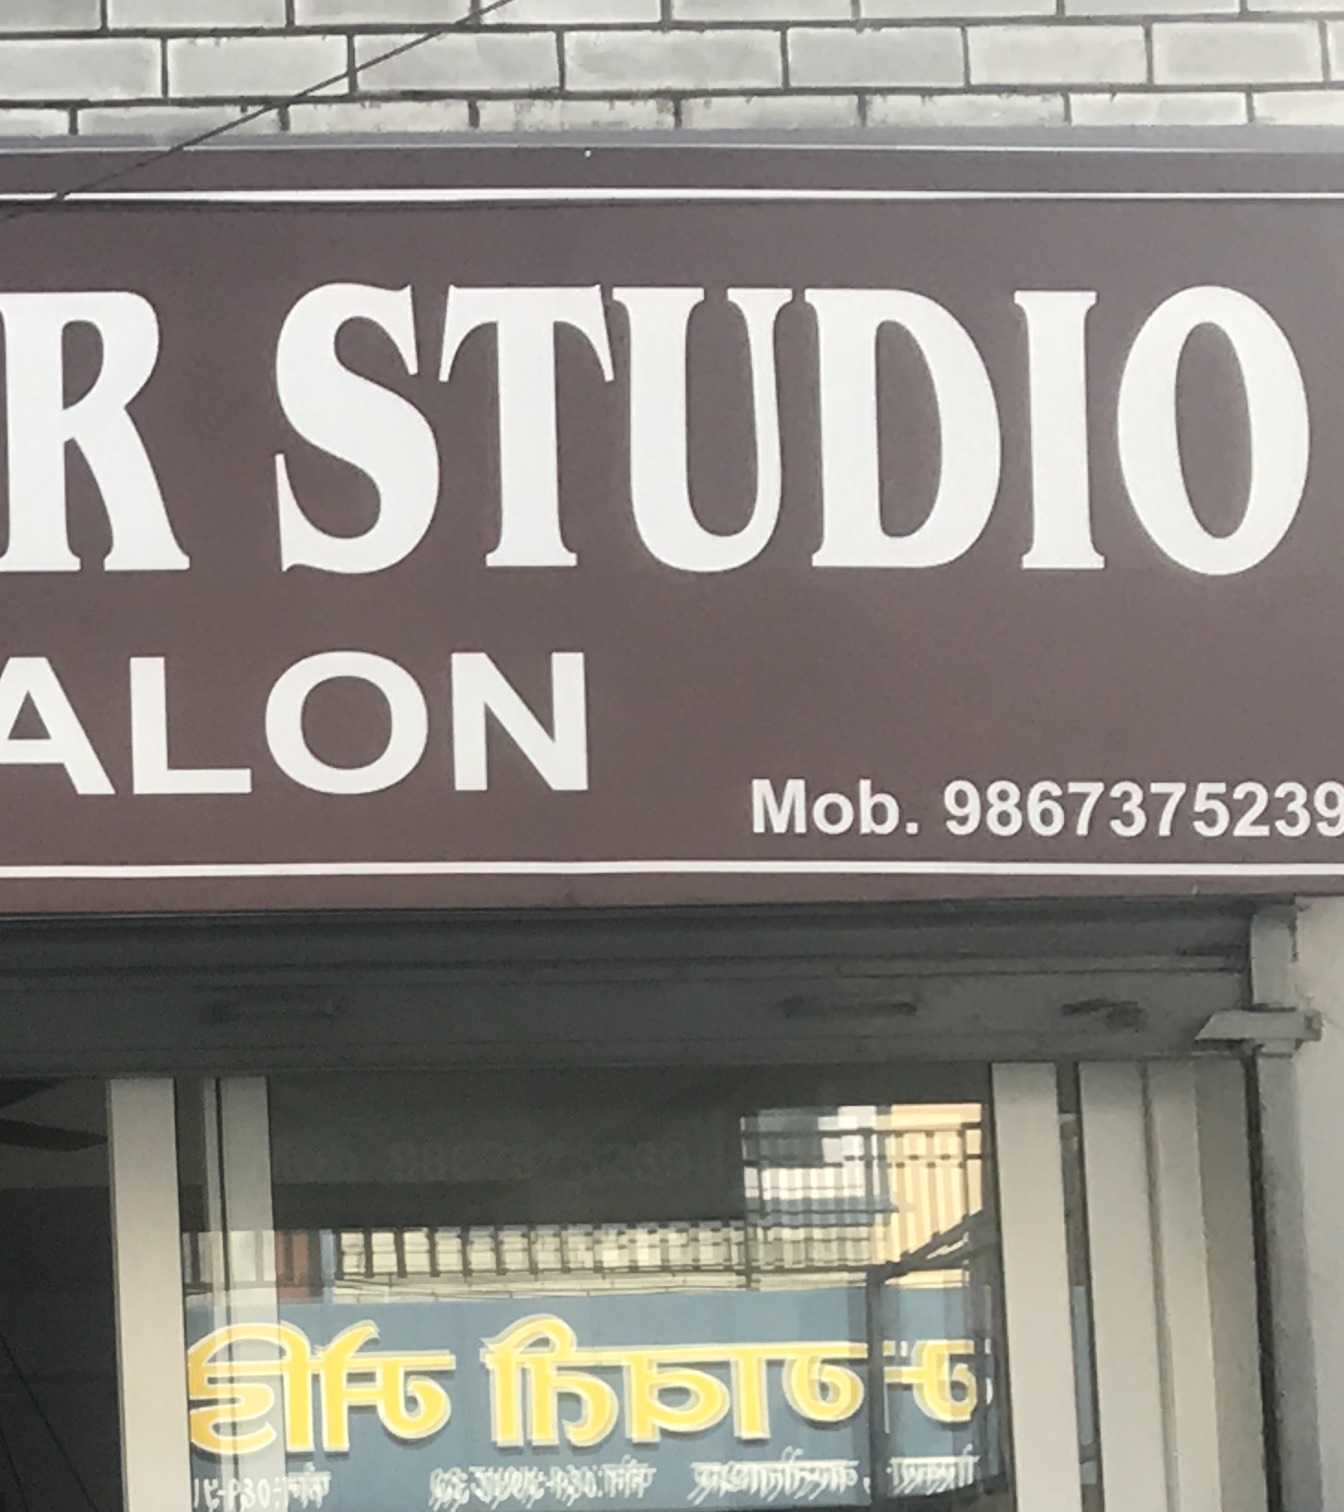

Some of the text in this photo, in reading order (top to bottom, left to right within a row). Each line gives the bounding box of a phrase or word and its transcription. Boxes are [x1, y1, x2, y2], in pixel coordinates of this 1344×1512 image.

[275, 283, 1310, 576] STUDIO
[750, 778, 1344, 838] Mob. 9867375239
